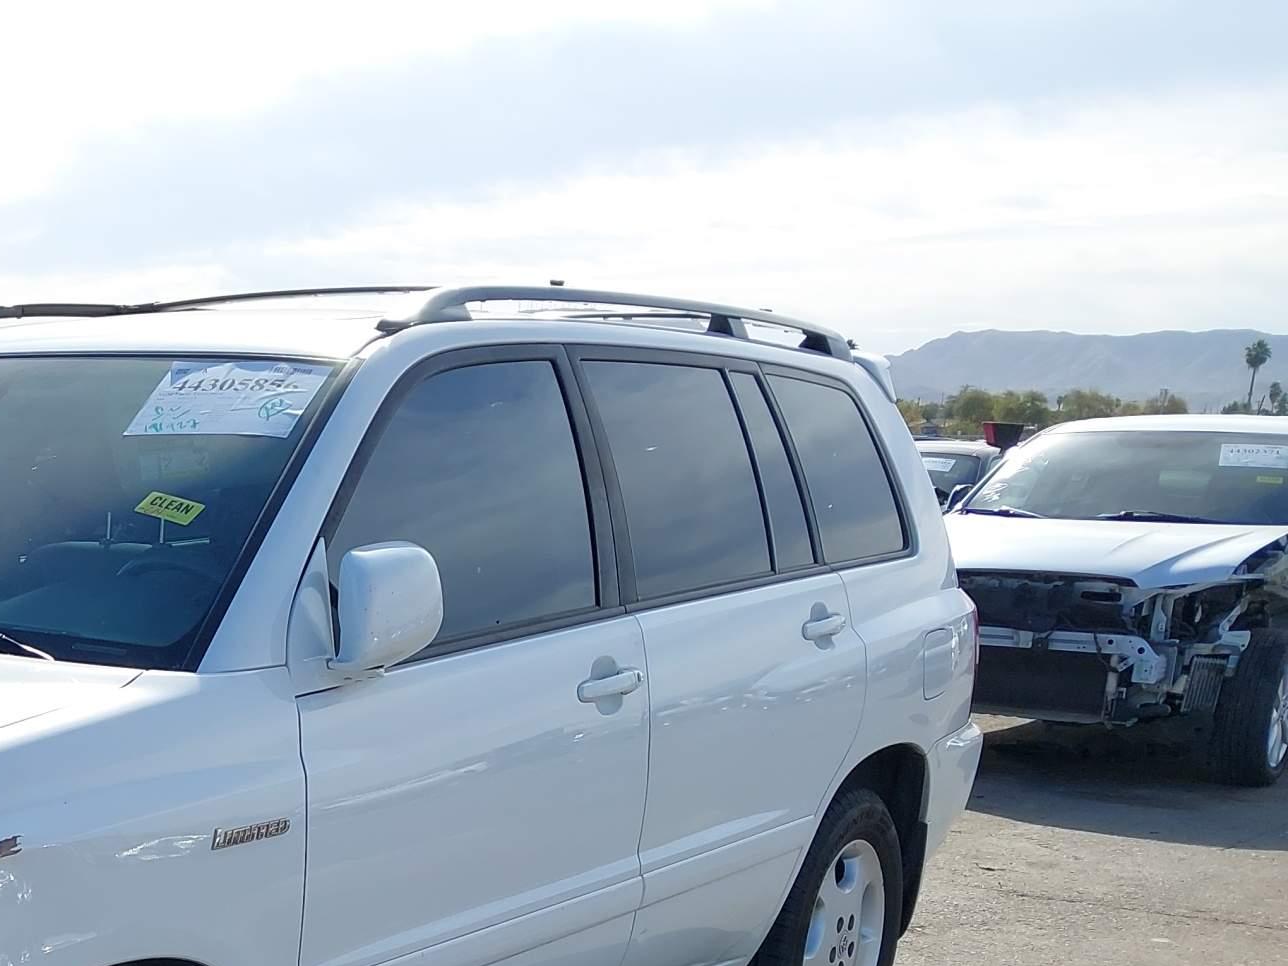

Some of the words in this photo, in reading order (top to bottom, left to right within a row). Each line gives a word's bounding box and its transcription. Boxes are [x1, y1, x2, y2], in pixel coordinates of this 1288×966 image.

[172, 377, 299, 393] 44305856
[150, 496, 194, 515] CLEAN
[211, 817, 291, 850] LIMITED
